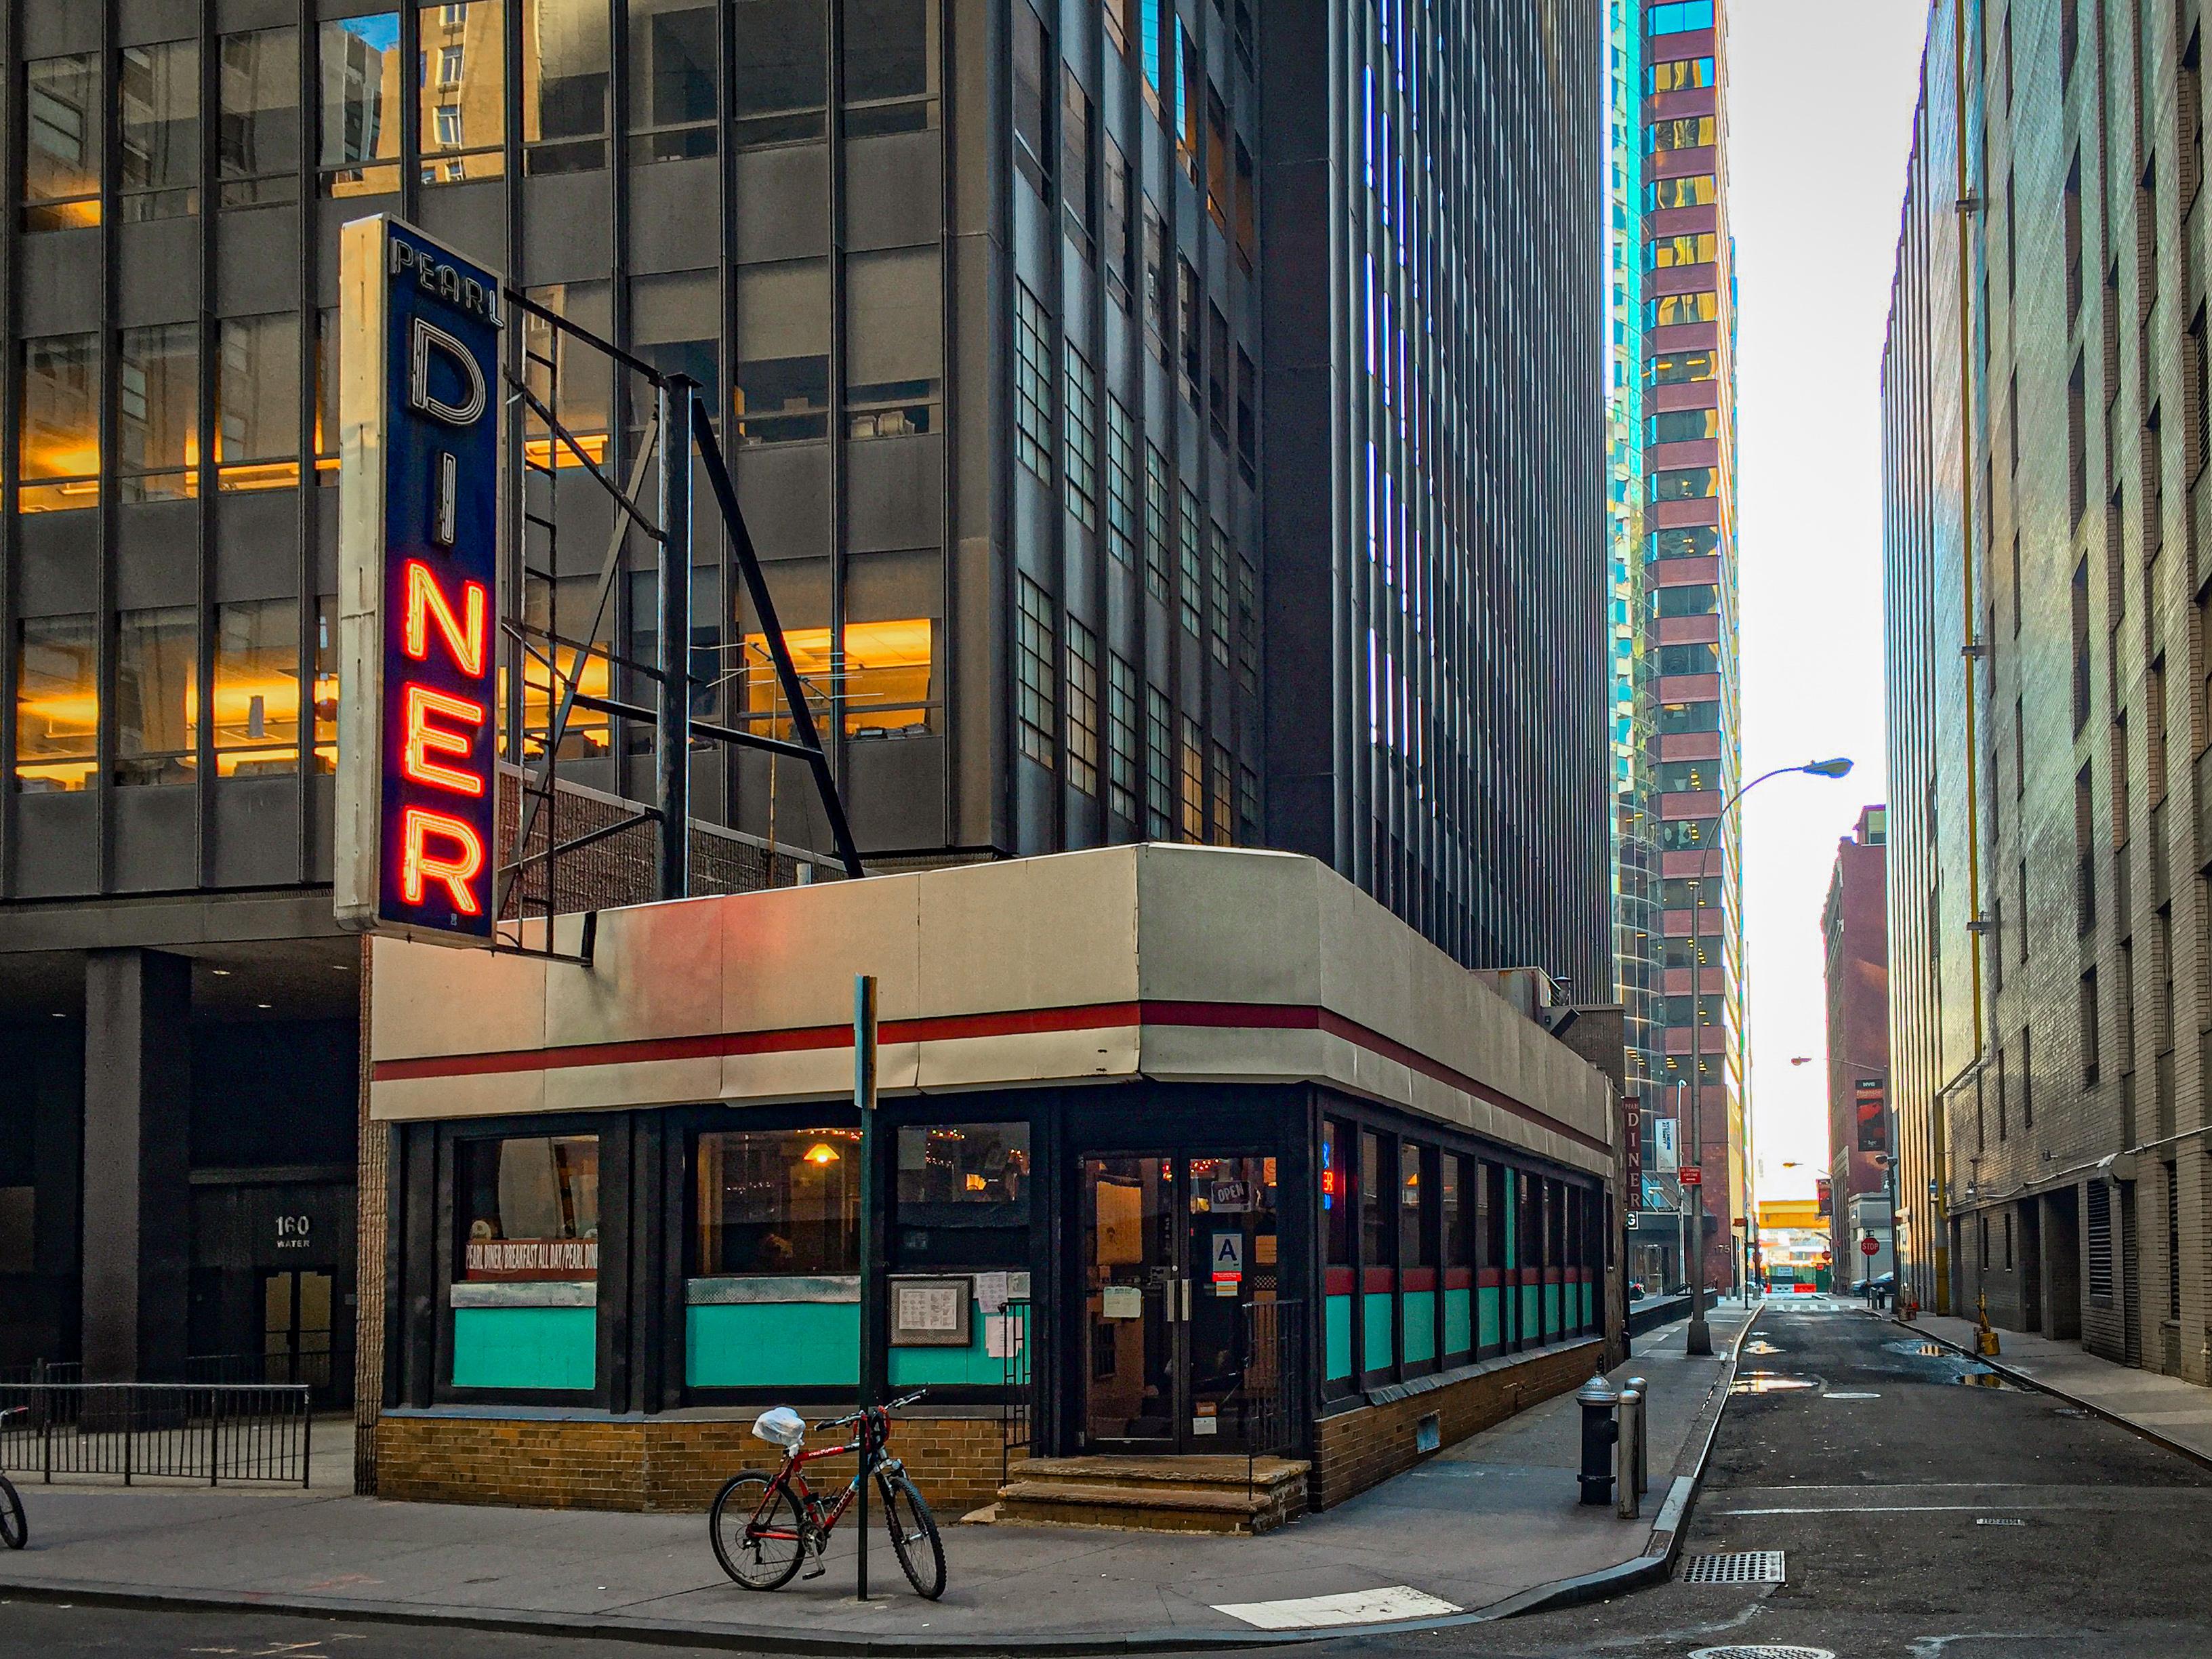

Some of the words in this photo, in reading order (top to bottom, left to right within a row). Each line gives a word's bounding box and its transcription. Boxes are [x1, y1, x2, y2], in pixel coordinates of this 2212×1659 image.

[388, 237, 504, 328] PEARL
[404, 316, 487, 918] DINER
[1628, 1112, 1640, 1208] DINER
[1217, 1182, 1245, 1203] OPEN
[1218, 1238, 1237, 1261] A
[1862, 1242, 1879, 1250] STOP
